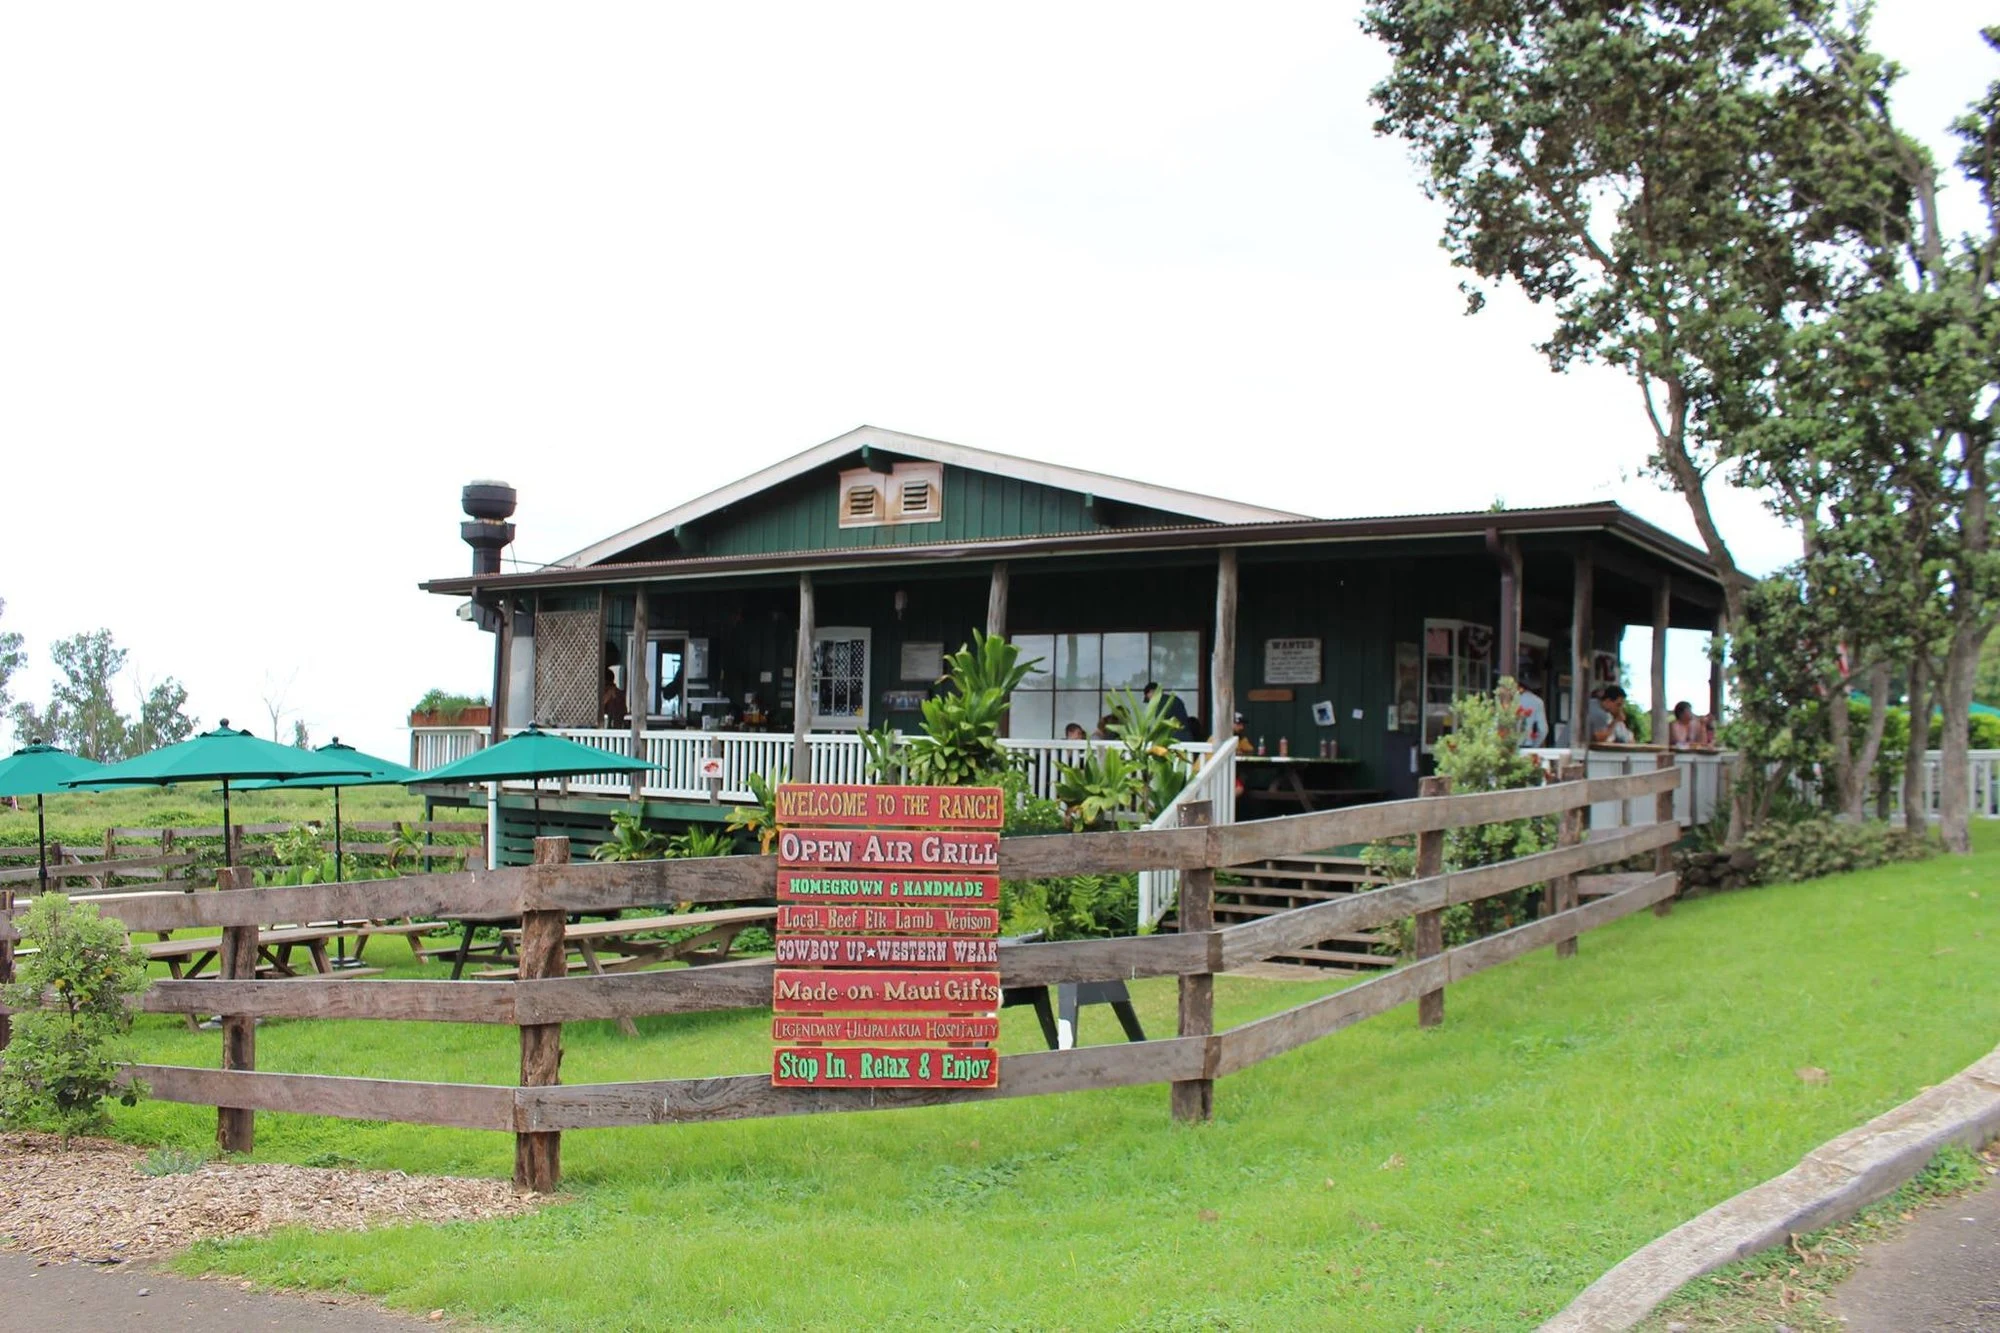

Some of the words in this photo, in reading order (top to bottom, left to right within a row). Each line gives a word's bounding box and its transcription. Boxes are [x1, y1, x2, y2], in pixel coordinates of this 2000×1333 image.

[1271, 641, 1314, 650] WANTED
[781, 791, 868, 817] WELCOME
[876, 793, 896, 816] TO
[903, 794, 930, 816] THE
[939, 794, 999, 820] RANCH
[789, 878, 884, 896] HOMEGROWN
[890, 882, 899, 896] &
[903, 880, 984, 897] HANDMADE
[784, 906, 819, 929] Local
[827, 908, 859, 929] Beef
[865, 909, 888, 929] Elk
[895, 909, 934, 930] Lamb
[945, 911, 992, 931] Venison
[776, 939, 841, 962] COWBOY
[846, 941, 866, 962] UP
[876, 940, 948, 963] WESTERN
[952, 939, 999, 963] WEAR
[776, 979, 839, 1002] Made
[847, 985, 874, 1001] on
[882, 979, 941, 1002] Maui
[944, 978, 999, 1002] Gifts
[774, 1020, 846, 1039] LEGENDARY
[926, 1020, 998, 1040] HOSPITALITY
[779, 1052, 819, 1083] Stop
[860, 1052, 911, 1080] Relax
[918, 1052, 931, 1080] &
[941, 1053, 992, 1082] Enjoy
